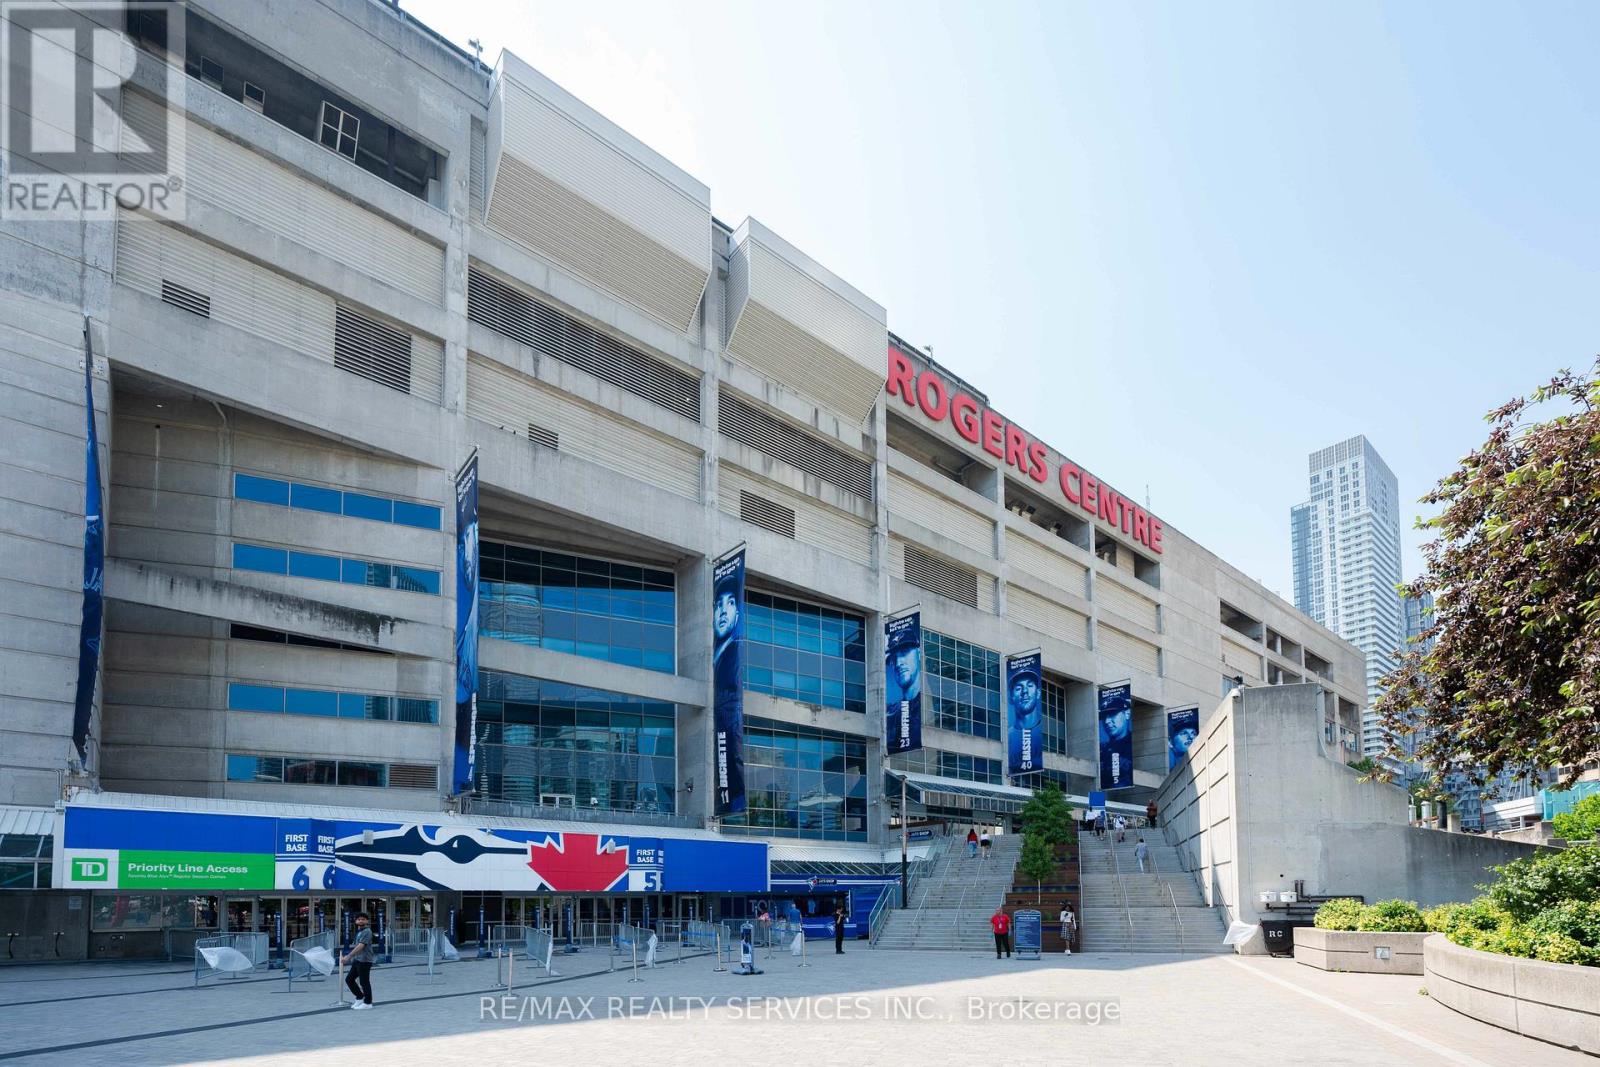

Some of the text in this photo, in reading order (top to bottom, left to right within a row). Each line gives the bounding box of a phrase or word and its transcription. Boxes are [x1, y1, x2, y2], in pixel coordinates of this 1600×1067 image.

[886, 345, 1163, 555] ROGERS CENTRE
[900, 700, 910, 737] HOFFMAN
[899, 738, 911, 748] 23
[1022, 729, 1032, 761] BASSITT
[717, 731, 729, 788] BICHETTE
[1020, 761, 1033, 771] 40
[1113, 776, 1119, 784] 5
[720, 788, 730, 804] 11
[285, 834, 309, 843] FIRST
[317, 835, 335, 844] FIRST
[285, 843, 307, 852] BASE
[317, 845, 335, 853] BASE
[75, 862, 105, 877] TD
[128, 863, 248, 873] Priority Line Access
[292, 864, 310, 891] 6
[322, 864, 336, 890] 6
[644, 871, 657, 891] 5
